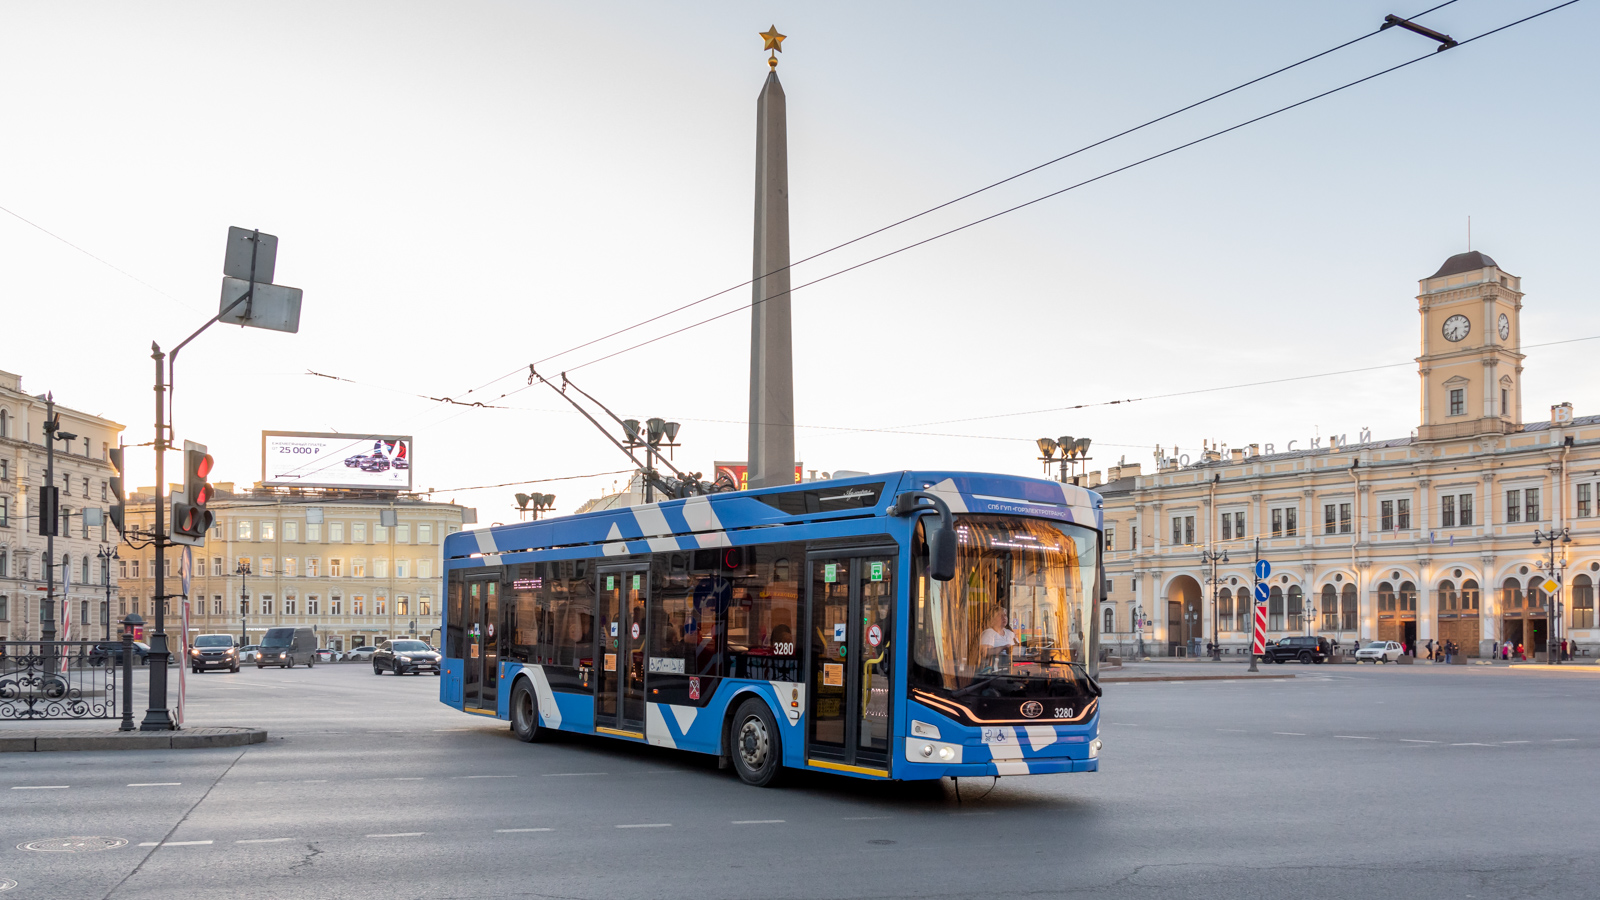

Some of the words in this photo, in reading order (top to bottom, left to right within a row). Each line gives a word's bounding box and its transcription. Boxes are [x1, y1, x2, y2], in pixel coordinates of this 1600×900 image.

[279, 446, 291, 454] 25
[292, 446, 312, 454] 000
[1158, 426, 1372, 469] МОСКОВСКИЙ
[1012, 506, 1066, 517] «ГОРЭЛЕКТРОТРАНС»
[773, 642, 794, 655] 3280
[1053, 707, 1074, 718] 3280
